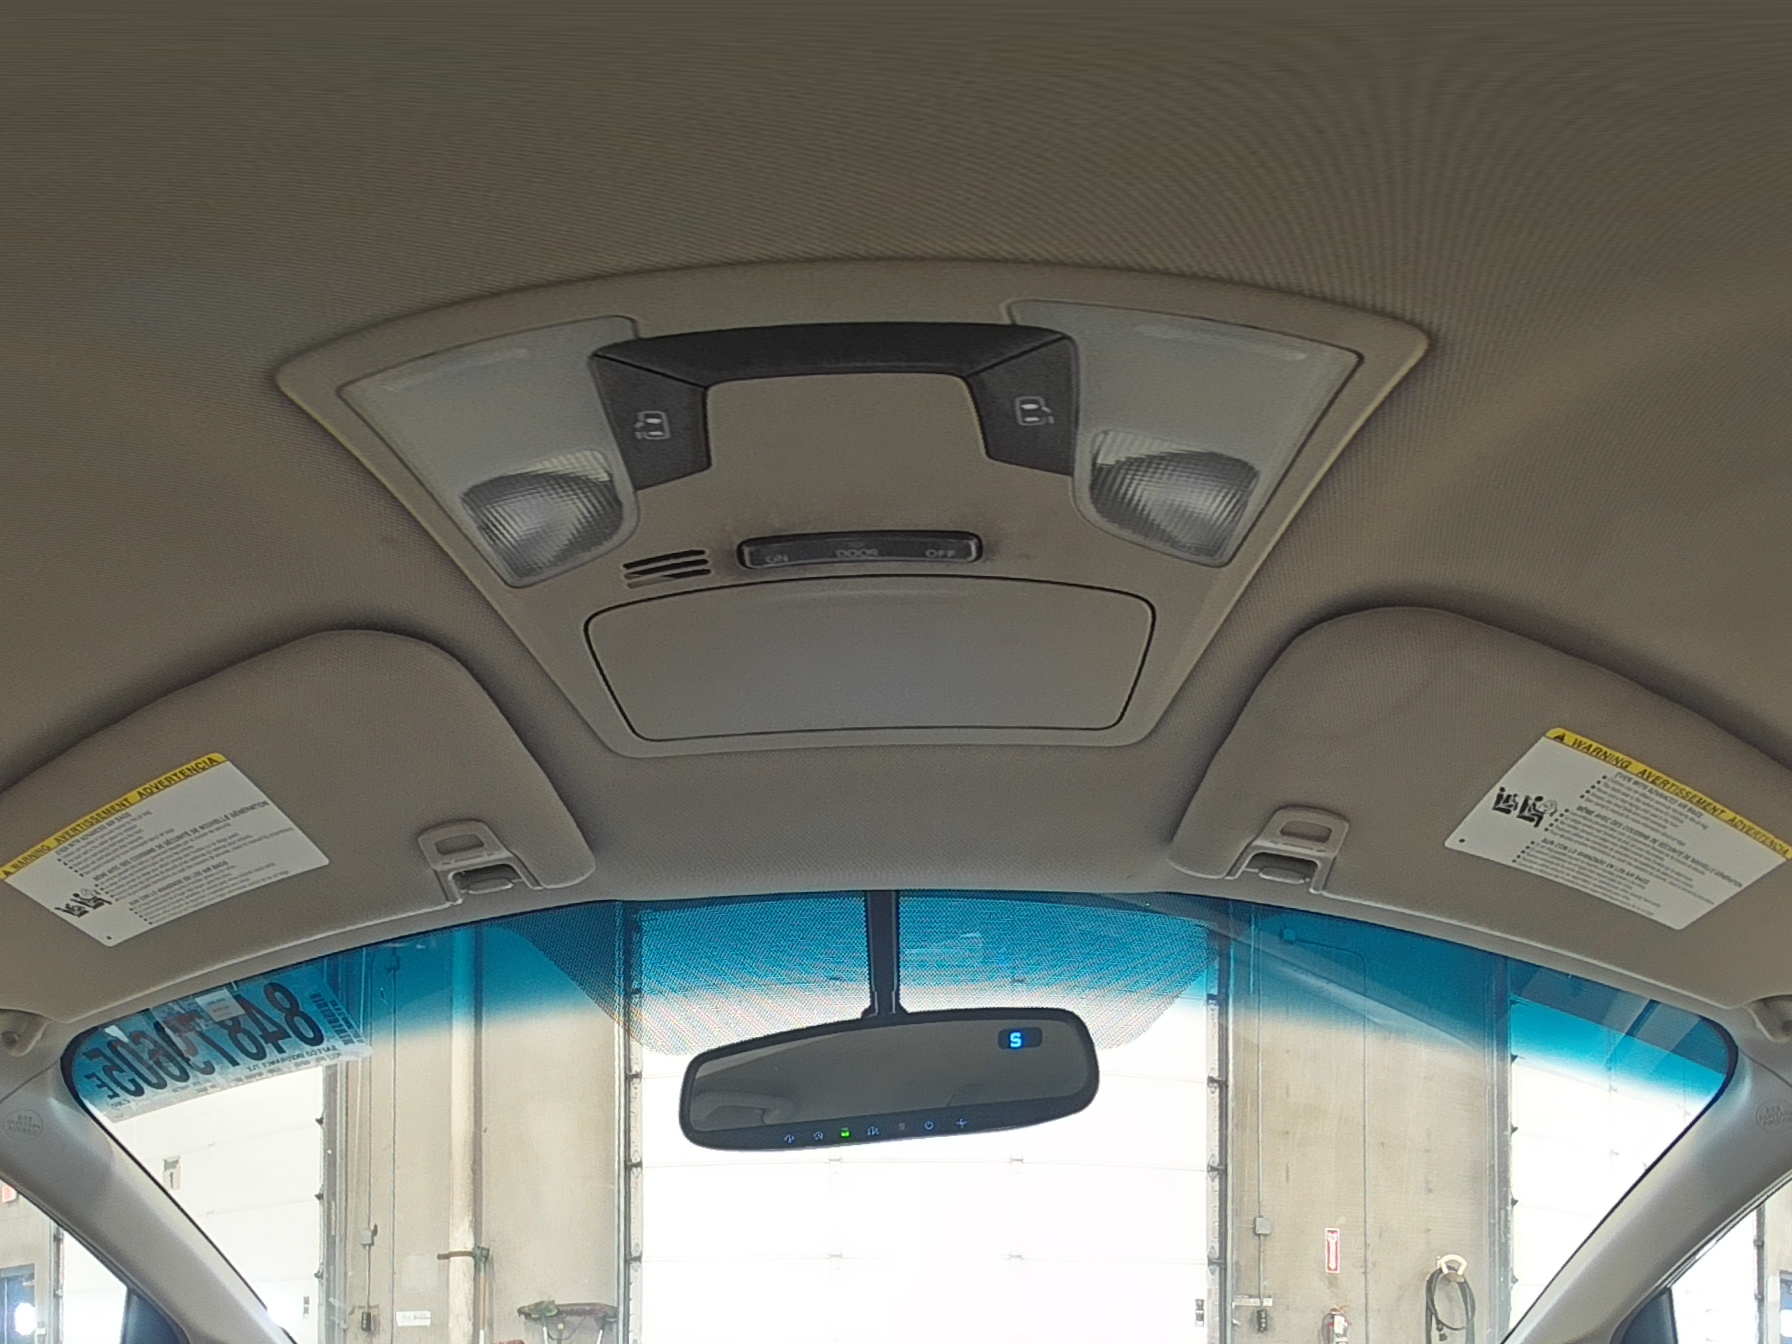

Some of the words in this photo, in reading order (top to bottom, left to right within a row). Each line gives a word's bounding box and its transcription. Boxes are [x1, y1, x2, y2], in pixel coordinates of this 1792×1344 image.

[765, 553, 789, 564] ON
[836, 549, 879, 559] DOOR
[925, 549, 956, 558] OFF
[1571, 737, 1632, 770] WARNING
[1637, 768, 1726, 817] AVERTISSEMENT
[10, 843, 50, 870] WARNING
[53, 797, 131, 846] AVERTISSEMENT
[136, 756, 219, 800] ADVERTENCIA
[1009, 1031, 1022, 1048] S
